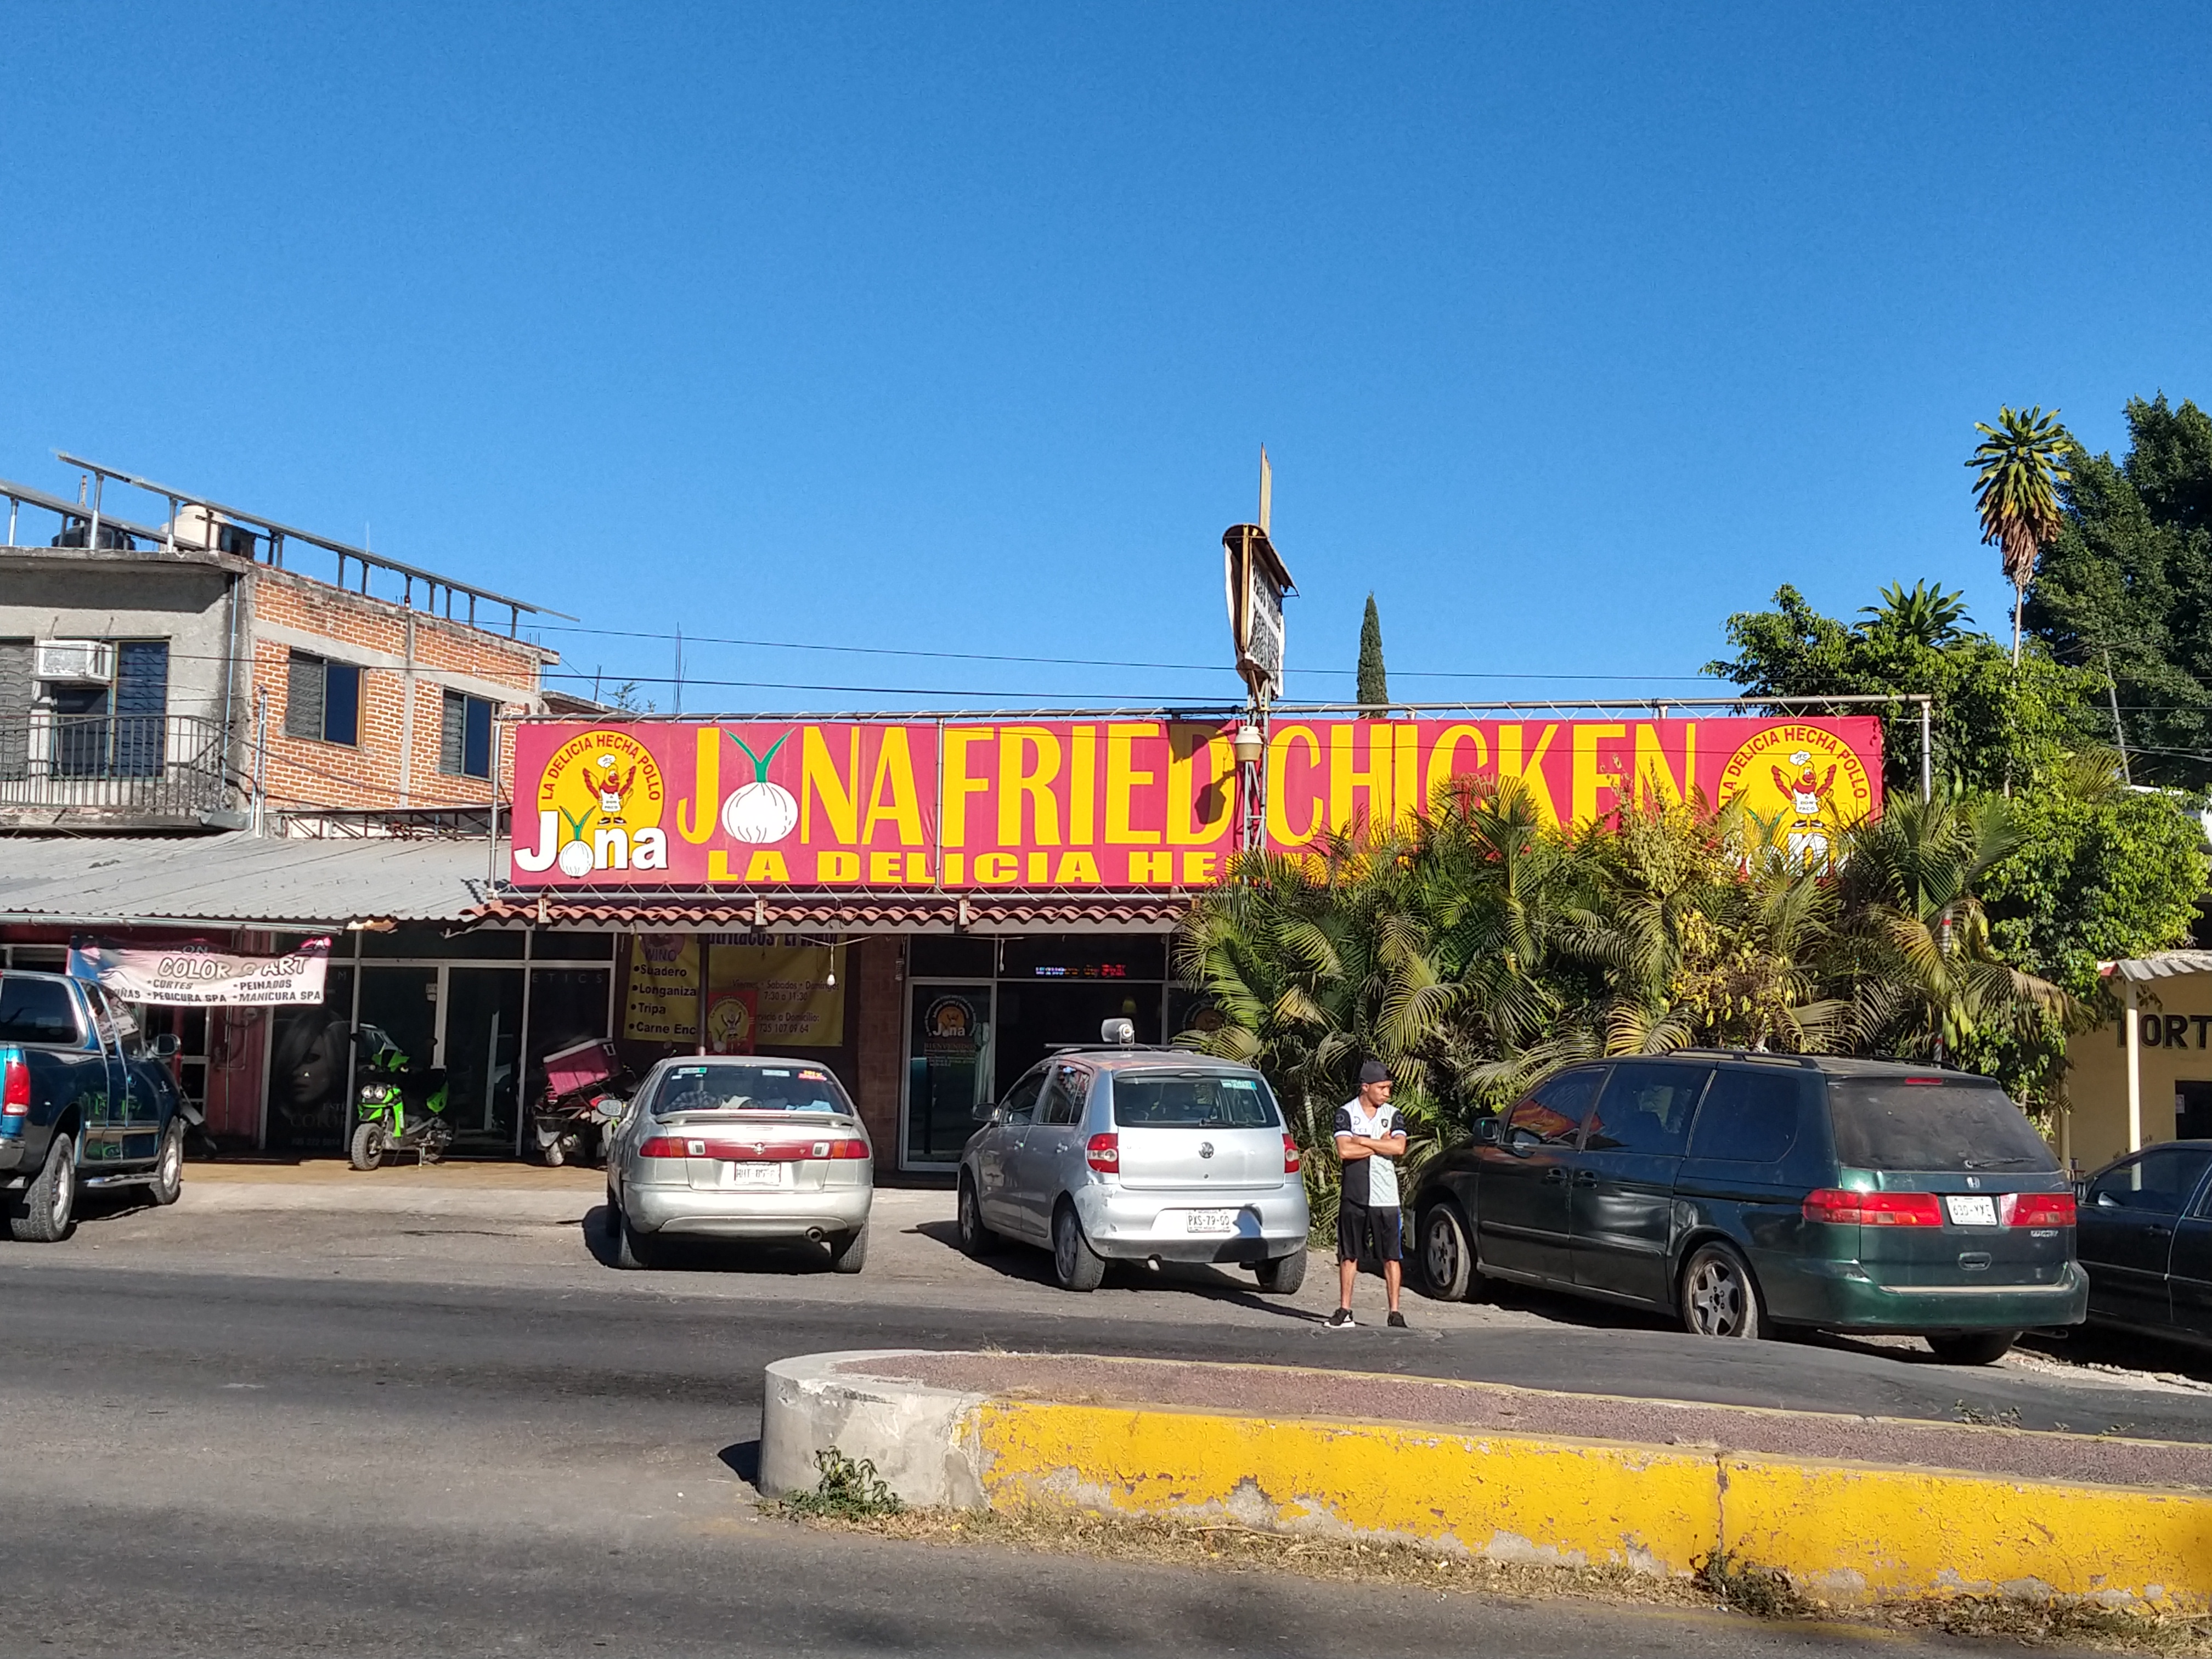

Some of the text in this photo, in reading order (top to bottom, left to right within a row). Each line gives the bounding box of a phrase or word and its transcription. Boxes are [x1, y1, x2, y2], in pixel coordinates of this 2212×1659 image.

[541, 735, 661, 801] LA DELICIA HECHA POLLO
[1728, 730, 1780, 777] DELICIA
[1784, 727, 1838, 755] HECHA
[1836, 748, 1868, 799] POLLO
[943, 723, 1235, 847] FRIED
[708, 850, 791, 882] LA
[817, 850, 1102, 884] DELICIA
[157, 957, 232, 980] COLOR
[261, 956, 311, 977] ART
[641, 963, 687, 977] Suadero
[153, 979, 194, 990] CORTES
[240, 979, 292, 991] PEINADOS
[640, 983, 697, 997] Longaniza
[154, 991, 227, 1002] PEDICURA SPA
[239, 991, 296, 1002] MANICURA
[301, 991, 321, 1000] SPA
[638, 1002, 666, 1015] Tripa
[636, 1022, 670, 1034] Carne
